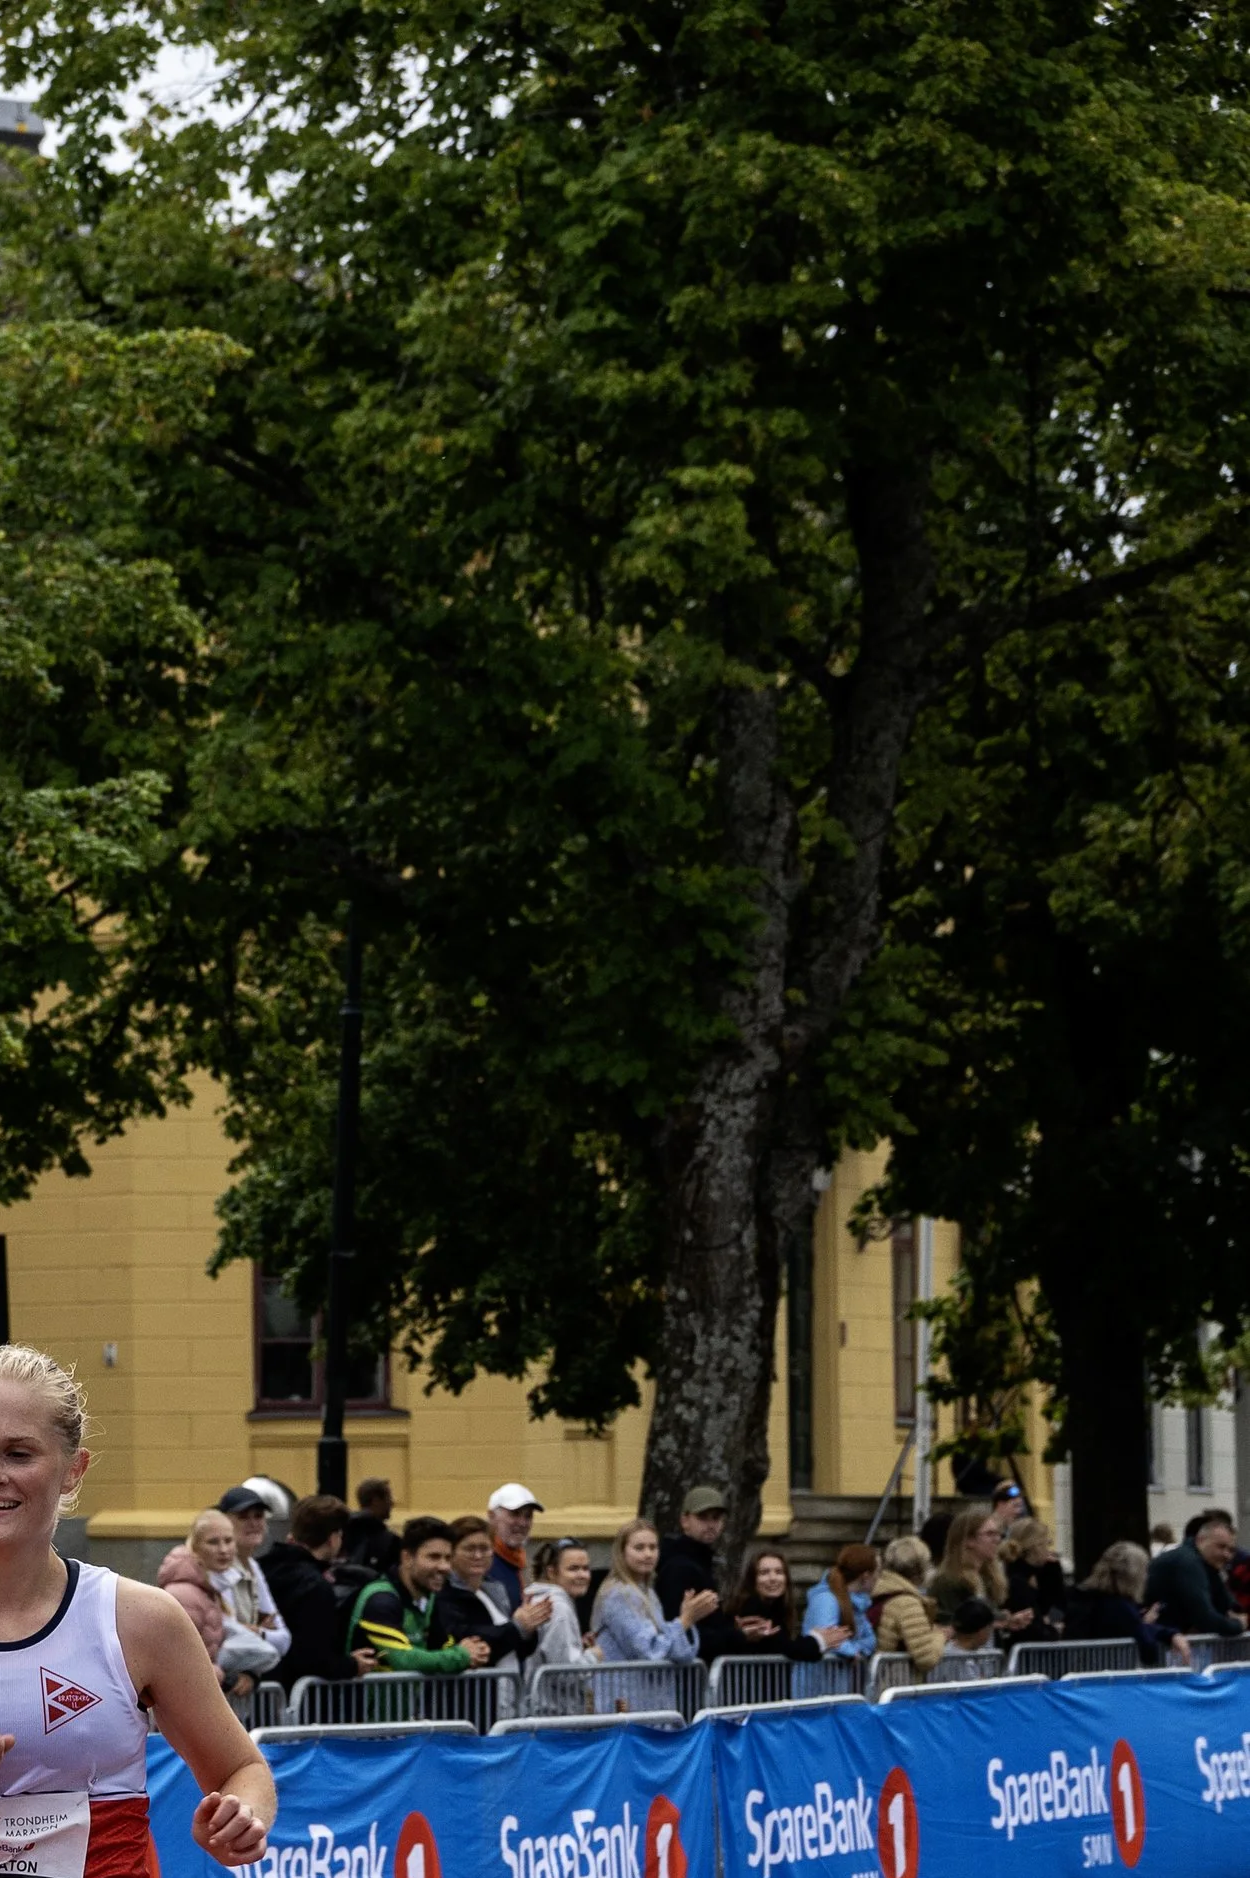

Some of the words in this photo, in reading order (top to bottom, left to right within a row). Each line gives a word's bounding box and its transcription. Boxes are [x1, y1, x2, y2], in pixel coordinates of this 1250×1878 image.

[987, 1745, 1110, 1842] SpareBank
[1118, 1762, 1136, 1843] 1
[4, 1814, 68, 1828] TRONDHEIM
[5, 1824, 58, 1837] MARATON
[1081, 1833, 1114, 1869] SMN
